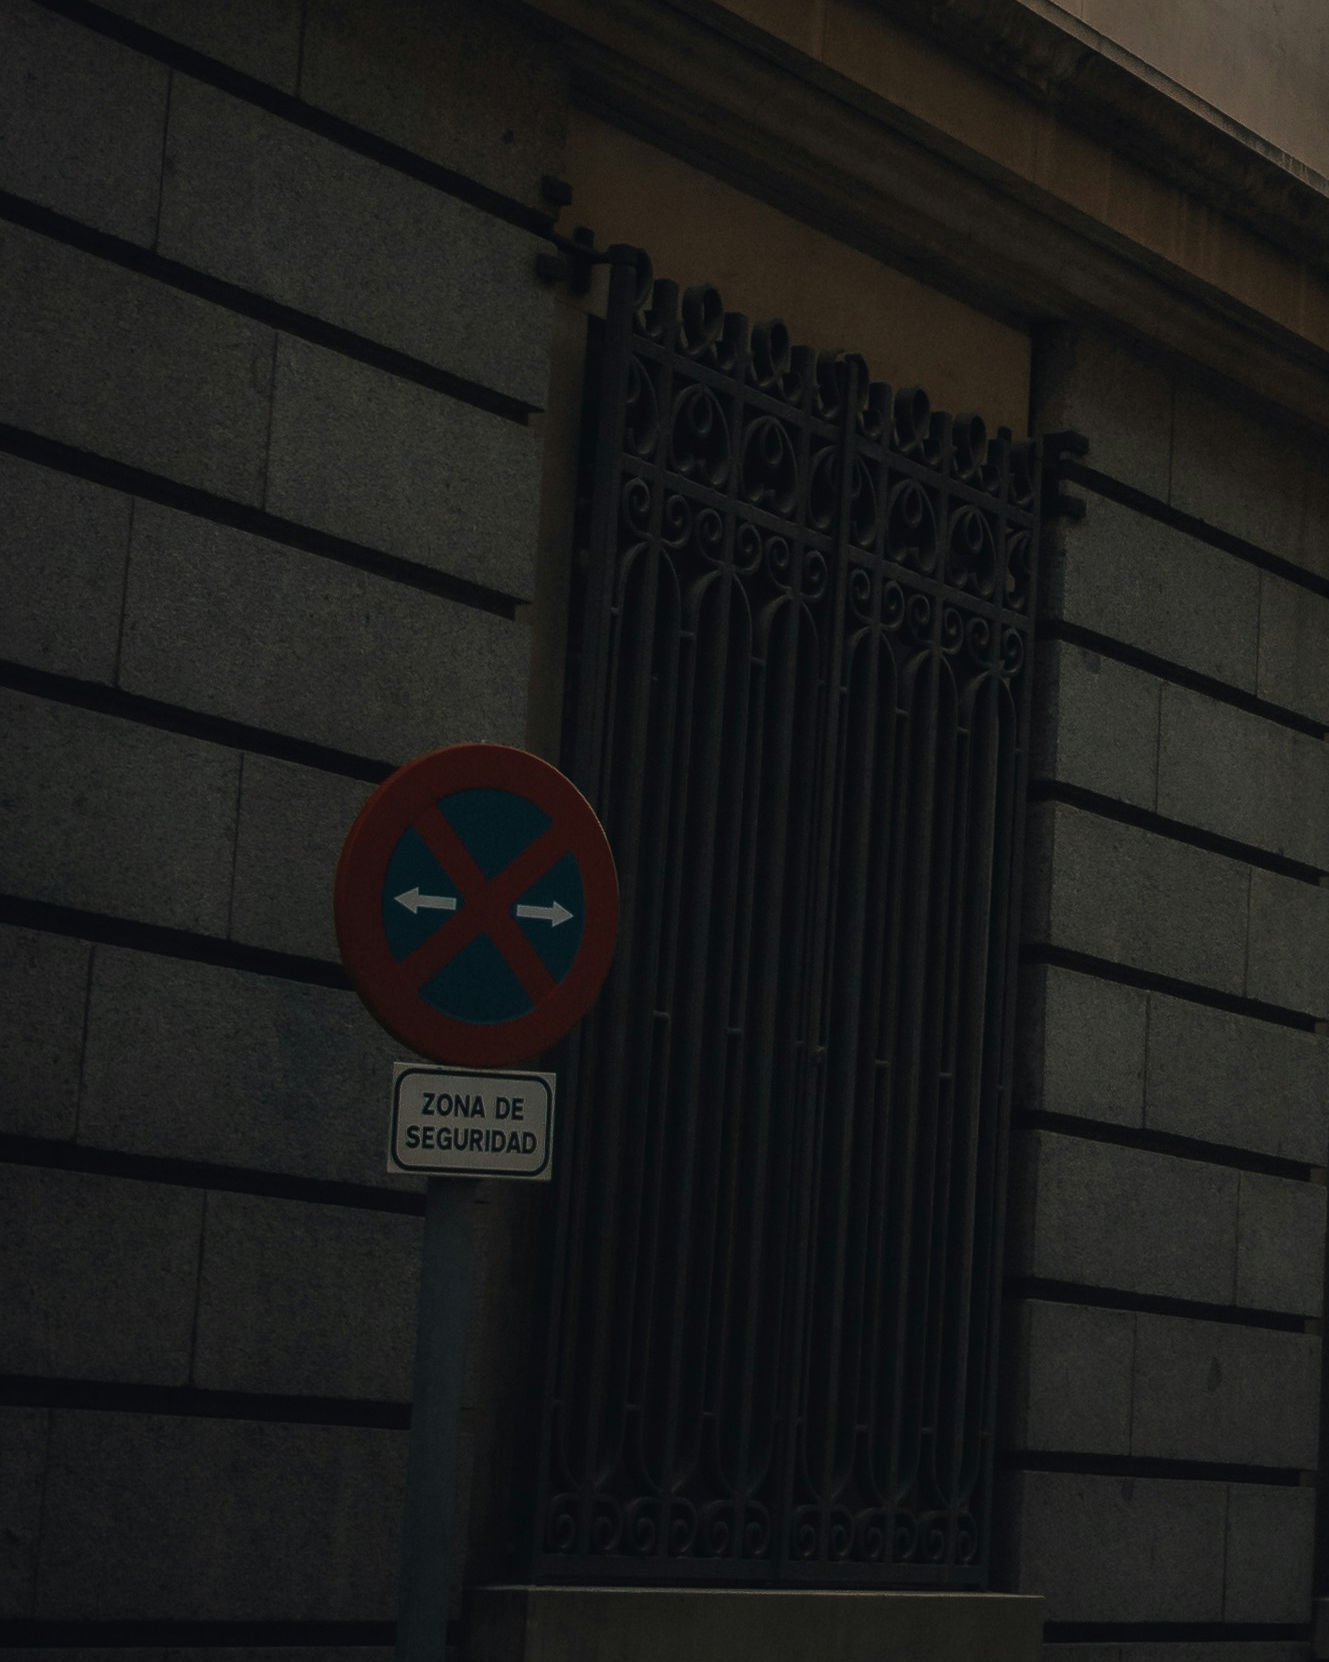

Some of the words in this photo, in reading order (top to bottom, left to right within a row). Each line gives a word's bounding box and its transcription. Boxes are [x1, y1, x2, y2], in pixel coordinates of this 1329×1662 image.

[422, 1092, 486, 1118] ZONA
[495, 1096, 525, 1120] DE
[405, 1125, 537, 1154] SEGURIDAD
